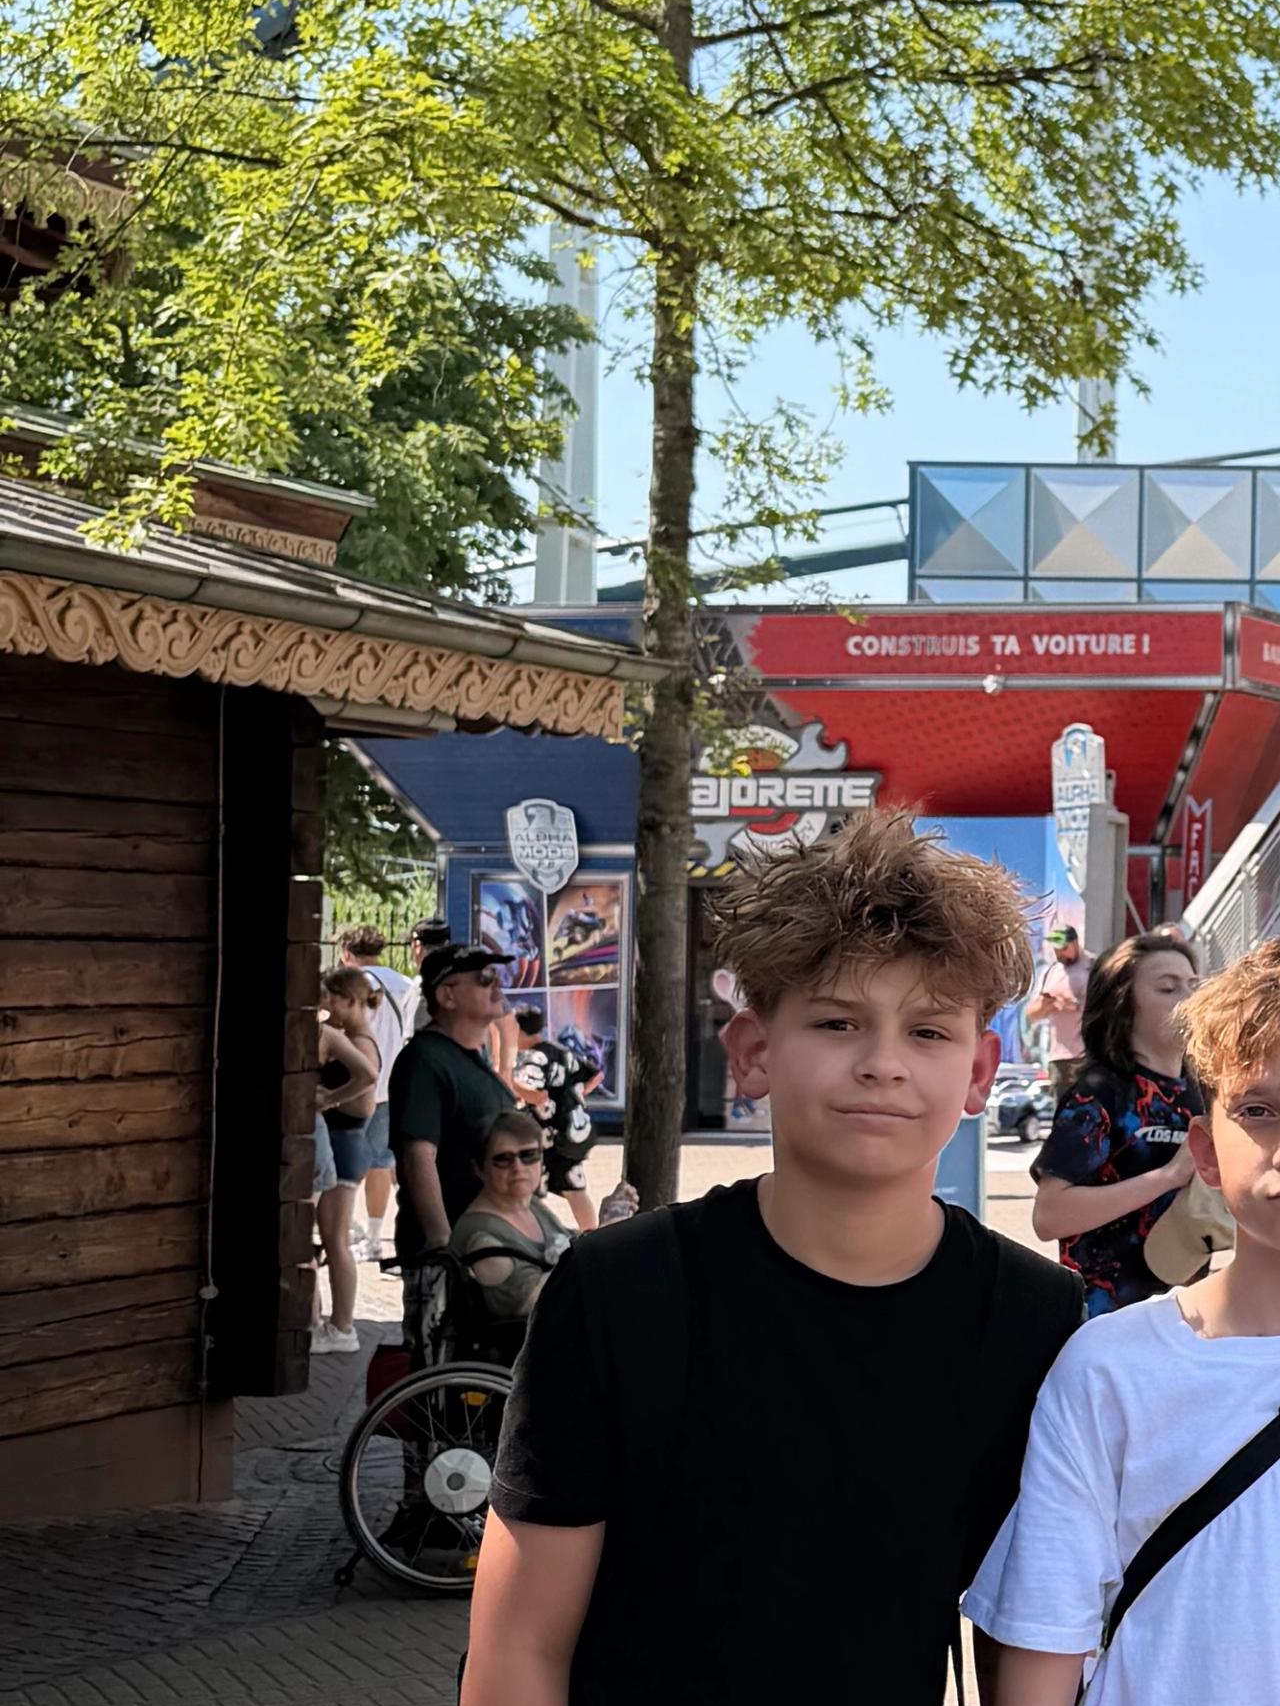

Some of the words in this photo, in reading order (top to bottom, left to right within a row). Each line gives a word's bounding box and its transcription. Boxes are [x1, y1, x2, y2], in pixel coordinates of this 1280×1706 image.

[846, 634, 981, 656] CONSTRUIS
[992, 634, 1021, 656] TA
[690, 777, 875, 817] aJORETTE
